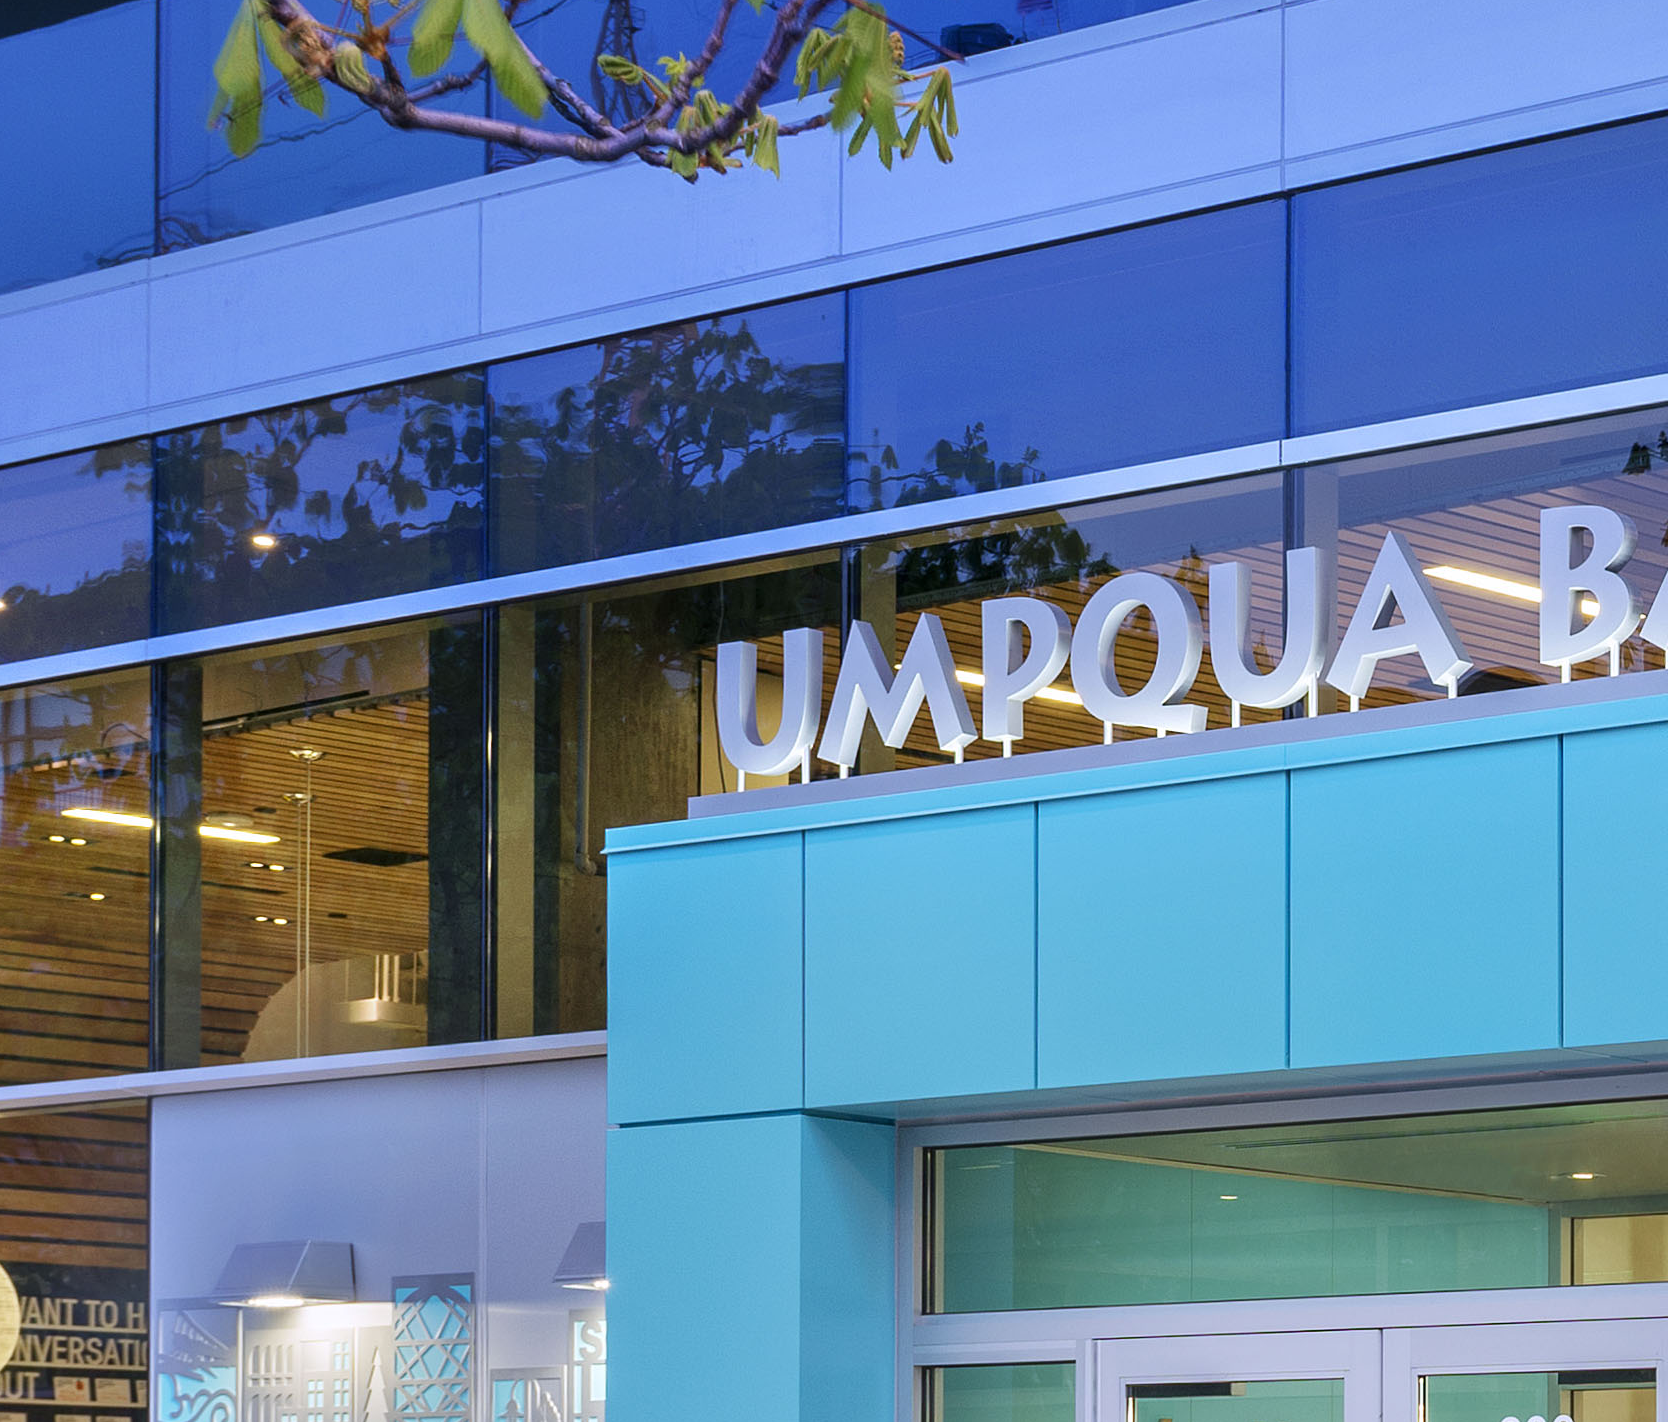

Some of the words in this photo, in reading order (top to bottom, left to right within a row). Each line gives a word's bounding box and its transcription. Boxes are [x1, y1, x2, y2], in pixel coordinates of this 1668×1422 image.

[716, 529, 1472, 778] UMPQUA
[19, 1296, 78, 1326] ANT
[84, 1299, 119, 1328] TO
